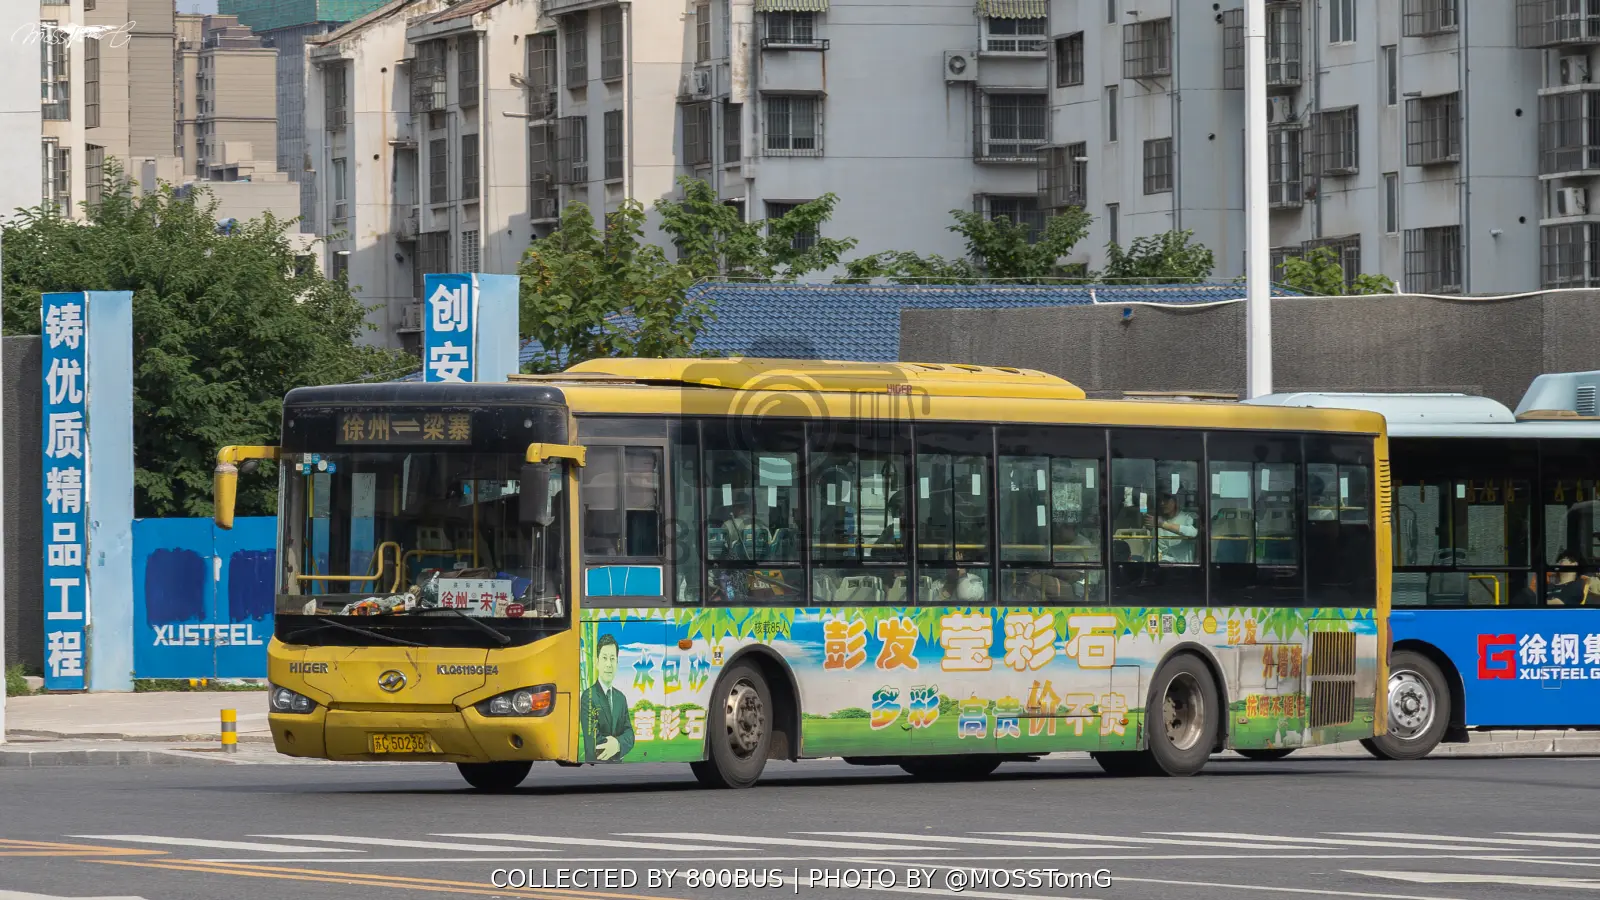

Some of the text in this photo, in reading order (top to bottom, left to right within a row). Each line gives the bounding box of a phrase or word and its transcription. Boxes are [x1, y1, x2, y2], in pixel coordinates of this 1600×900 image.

[342, 413, 471, 442] 徐州 梁寨
[45, 302, 84, 677] 铸优质精品工程
[153, 624, 263, 646] XUSTEEL
[754, 620, 789, 635] 核载85人
[822, 610, 1118, 672] 彭发 莹彩石
[1227, 618, 1257, 646] 彭发
[1518, 633, 1600, 665] 徐钢集
[289, 662, 328, 674] HIGER
[436, 664, 499, 676] KLQ6119GE4
[632, 649, 712, 694] 水包砂
[1519, 667, 1589, 680] XUSTEEL
[870, 679, 1128, 738] 多彩 高贵价不贵
[633, 708, 707, 742] 莹彩石
